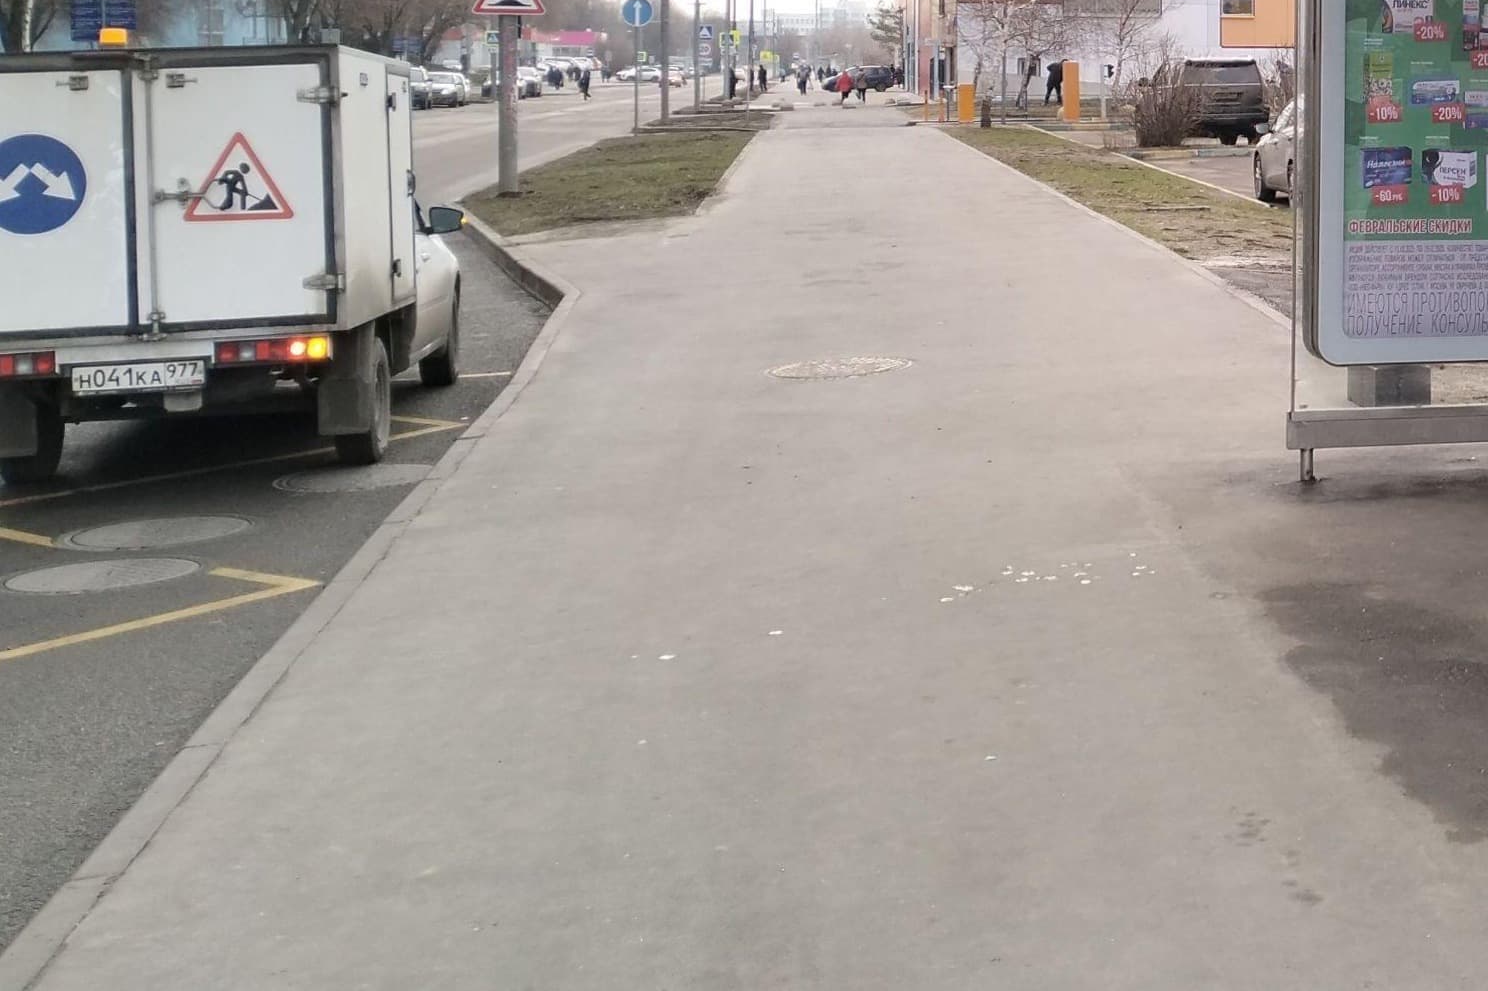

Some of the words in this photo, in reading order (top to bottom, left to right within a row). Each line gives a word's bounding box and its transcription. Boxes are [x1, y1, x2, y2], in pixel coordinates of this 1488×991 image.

[1416, 26, 1444, 39] -20%
[1369, 107, 1398, 121] -10%
[1434, 107, 1462, 121] -20%
[1432, 189, 1459, 201] -10%
[1349, 219, 1427, 233] ФЕВРАЛЬСКИЕ
[1428, 219, 1472, 233] СКИДКИ
[1348, 292, 1408, 314] ИМЕЮТСЯ
[1347, 314, 1423, 336] ПОЛУЧЕНИЕ
[80, 368, 162, 388] Н041КА
[166, 362, 198, 378] 977
